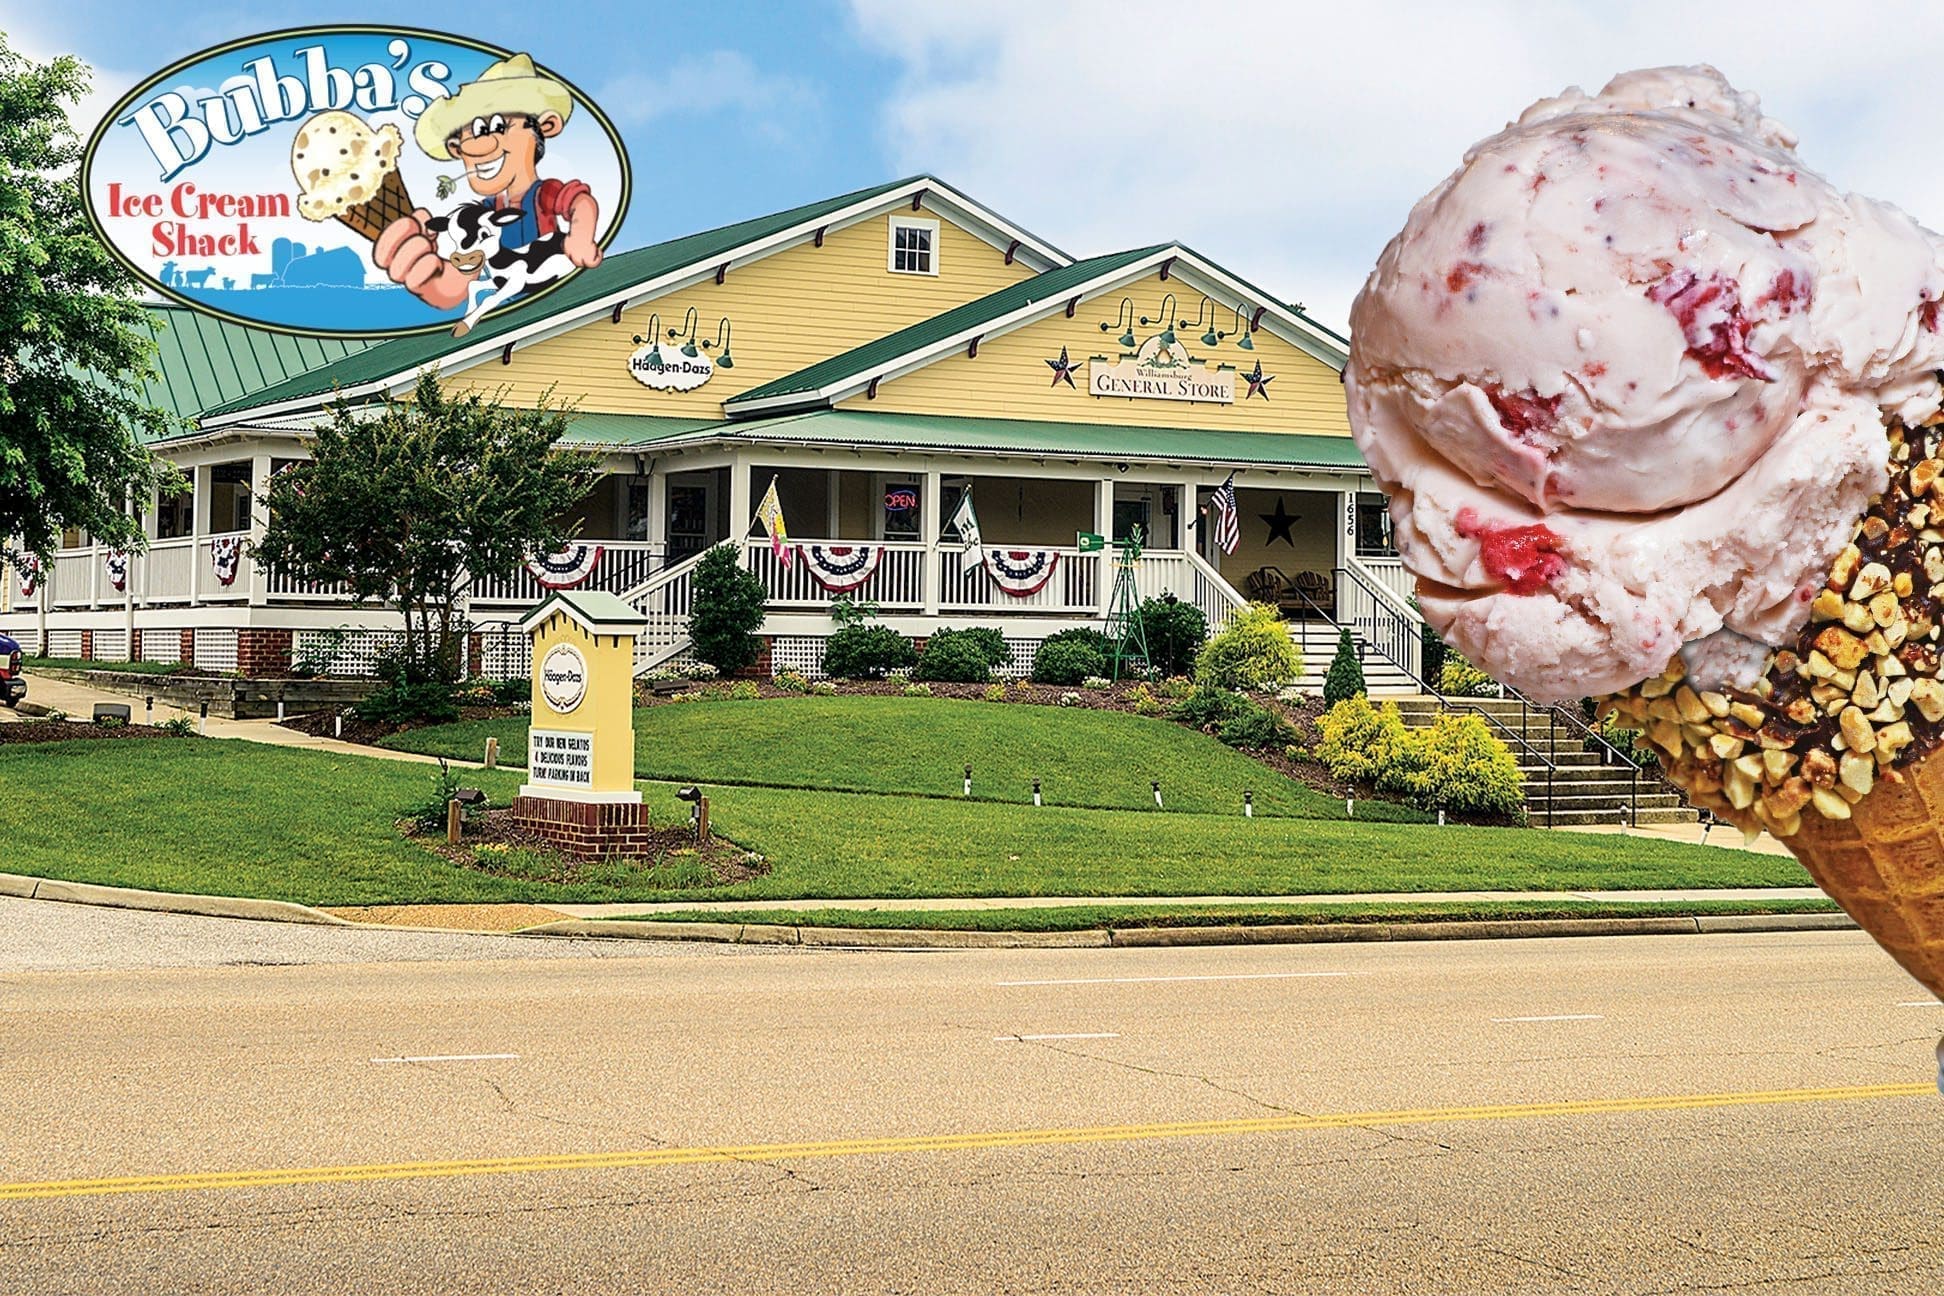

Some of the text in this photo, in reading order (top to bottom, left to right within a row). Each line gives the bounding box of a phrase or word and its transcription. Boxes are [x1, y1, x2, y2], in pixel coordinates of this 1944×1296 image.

[1136, 368, 1192, 382] Williamsburg
[1096, 373, 1230, 399] GENERAL STORE
[884, 494, 916, 508] OPEN
[1346, 492, 1354, 536] 1656
